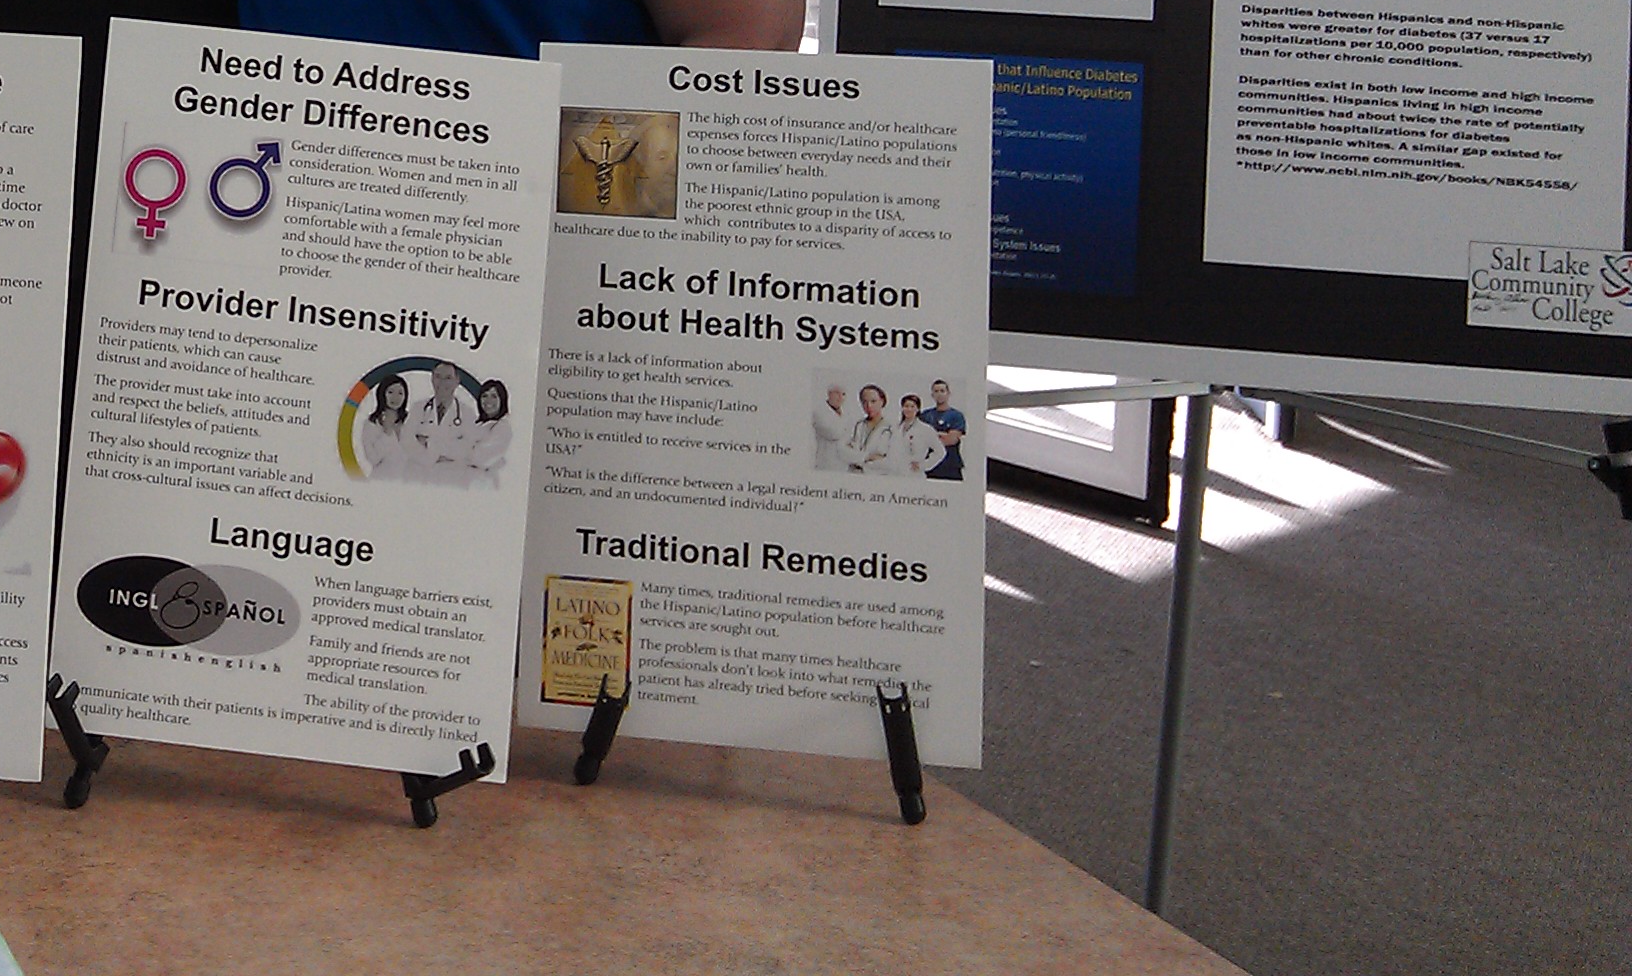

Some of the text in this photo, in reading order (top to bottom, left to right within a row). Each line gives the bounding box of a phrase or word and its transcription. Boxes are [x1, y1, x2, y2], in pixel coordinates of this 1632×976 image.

[200, 46, 470, 100] Need to Address
[668, 65, 860, 99] Cost Issues
[997, 63, 1138, 83] that Influence Diabetes
[1067, 84, 1132, 100] Population
[9, 124, 34, 135] care
[174, 85, 489, 144] Gender Differences
[686, 111, 957, 136] The high cost of insurance and/or healthcare
[290, 139, 520, 175] Gender differences must be taken into
[1490, 247, 1590, 276] Salt Lake
[599, 262, 919, 308] Lack of Information
[1471, 269, 1595, 303] Community
[138, 278, 489, 350] Provider Insensitivity
[577, 302, 939, 351] about Health Systems
[1531, 296, 1614, 331] College
[210, 517, 373, 567] Language
[575, 527, 928, 583] Traditional Remedies
[108, 589, 159, 610] INGL
[314, 576, 493, 609] When language barriers exist,
[555, 597, 621, 616] LATINO
[564, 625, 610, 642] FOLK
[306, 671, 427, 695] medical translation.
[637, 690, 699, 705] treatment.
